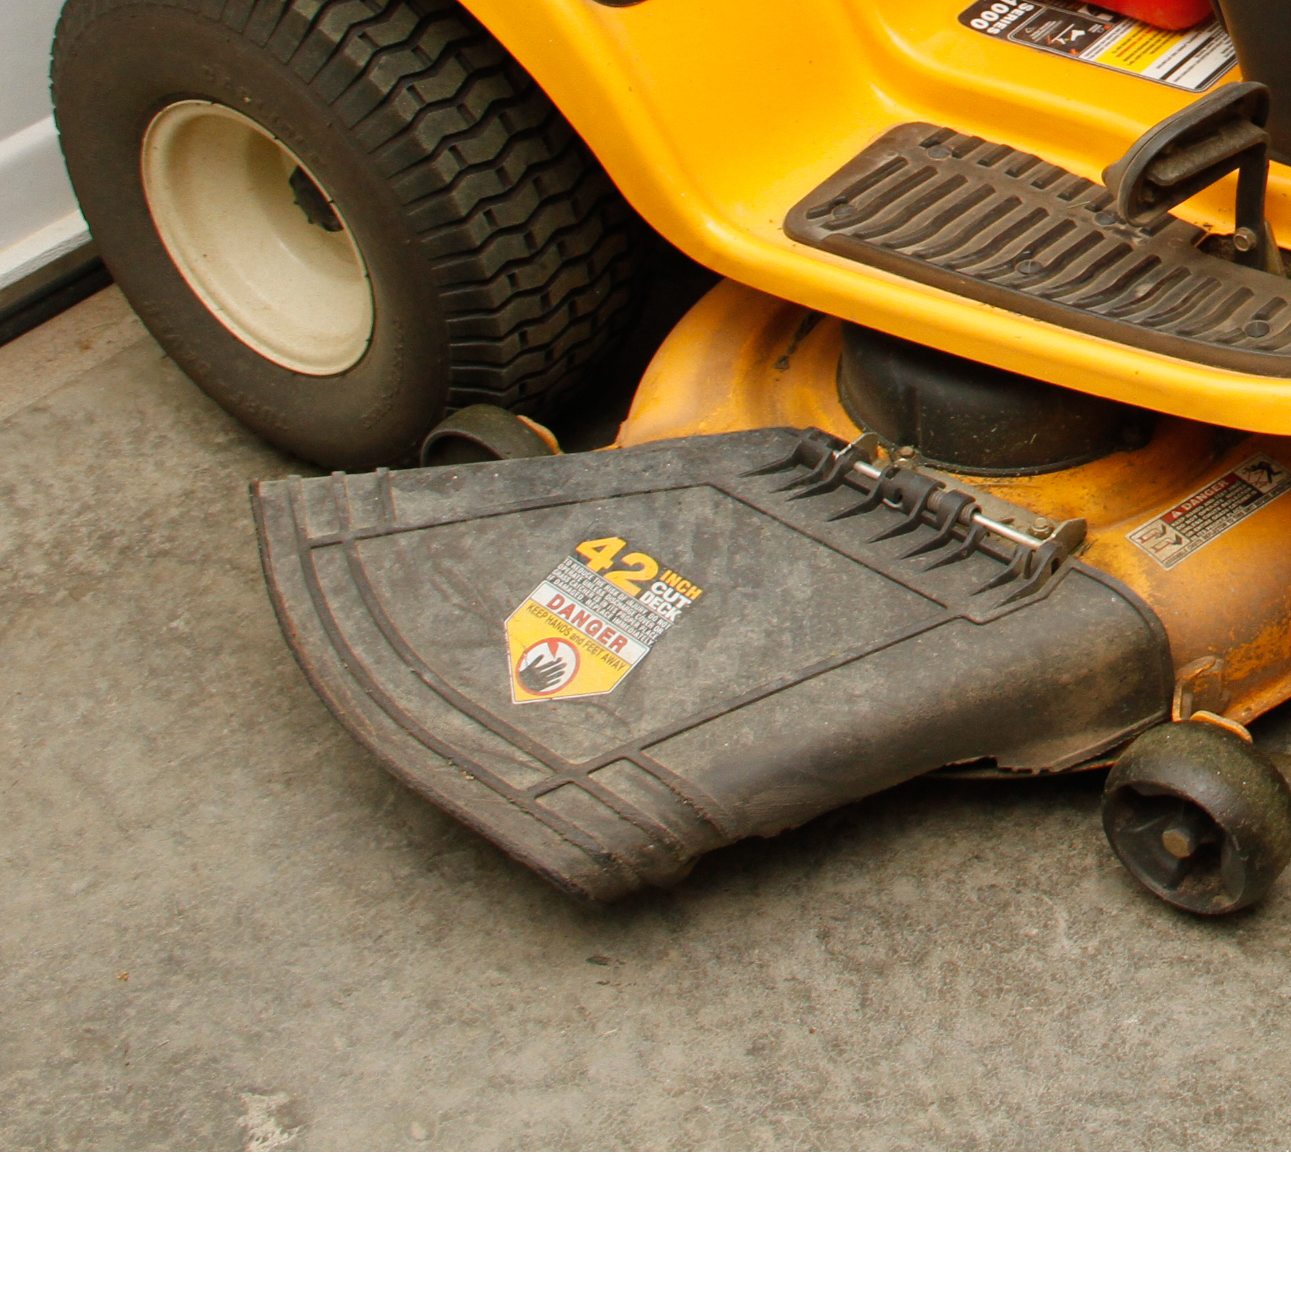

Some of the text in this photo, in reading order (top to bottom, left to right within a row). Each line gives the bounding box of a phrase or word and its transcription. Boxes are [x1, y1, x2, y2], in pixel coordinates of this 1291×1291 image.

[987, 2, 1035, 34] SERIES
[1180, 478, 1229, 511] DANGER
[576, 537, 659, 597] 42
[556, 562, 584, 582] OPERATE
[603, 593, 637, 616] DISCHARGE
[633, 612, 656, 629] COVER
[652, 624, 664, 634] OR
[650, 581, 693, 608] CUT
[659, 569, 703, 600] INCH
[584, 598, 614, 620] REPLACE
[592, 576, 606, 587] THE
[602, 583, 620, 596] RISK
[616, 592, 628, 601] OF
[655, 618, 672, 630] NOT
[592, 594, 602, 602] IS
[615, 610, 640, 627] PROPER
[639, 591, 682, 621] DECK
[525, 602, 627, 671] KEEP HANDS and FEET AWAY
[545, 592, 631, 653] DANGER
